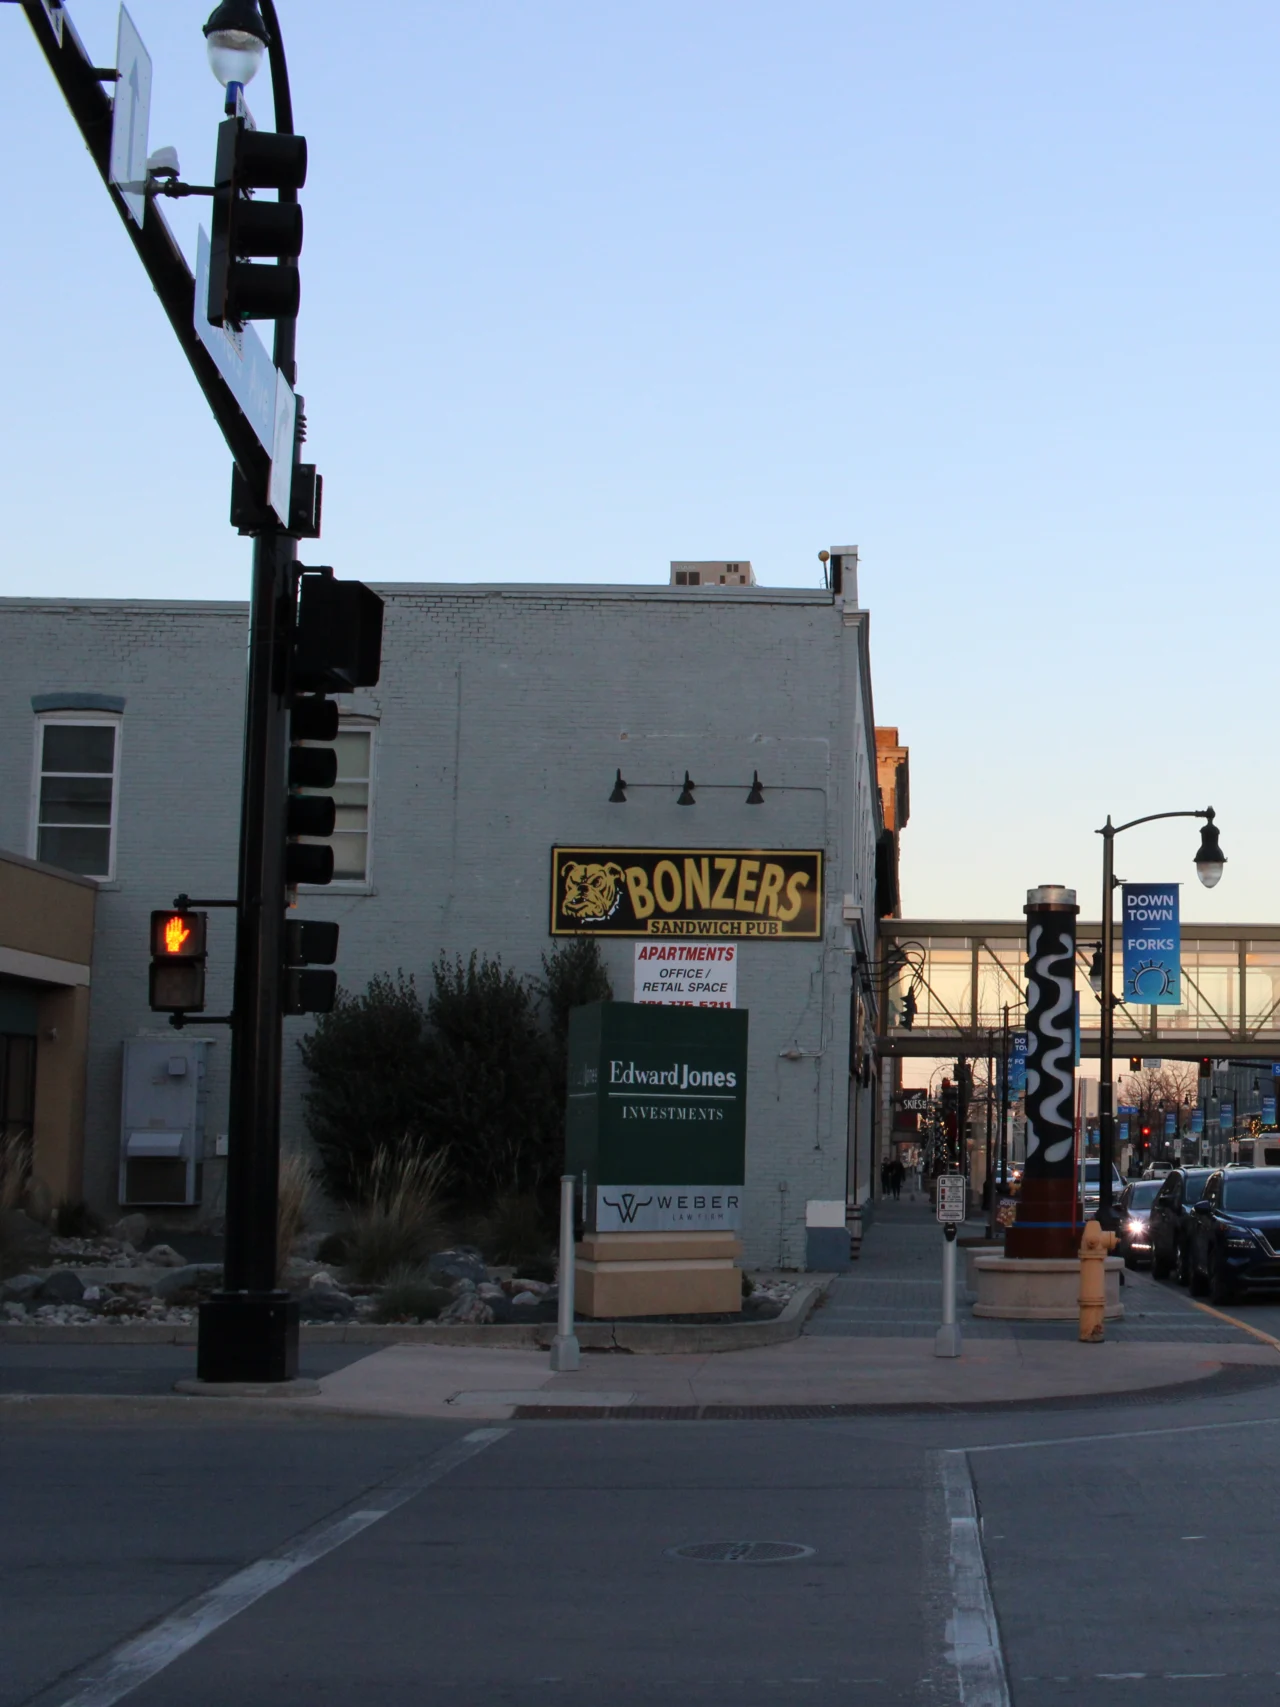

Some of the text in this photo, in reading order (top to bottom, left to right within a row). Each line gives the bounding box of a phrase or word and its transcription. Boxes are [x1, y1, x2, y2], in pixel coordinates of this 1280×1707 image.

[624, 857, 811, 922] BONZERS
[1127, 894, 1174, 906] DOWN
[1127, 909, 1173, 921] TOWN
[651, 920, 779, 935] SANDWICH PUB
[1127, 939, 1175, 951] FORKS
[638, 946, 735, 962] APARTMENTS
[659, 968, 703, 979] OFFICE
[642, 982, 728, 993] RETAIL SPACE
[609, 1060, 679, 1086] Edward
[680, 1064, 737, 1089] Jones
[903, 1099, 922, 1110] SKIES
[622, 1106, 724, 1121] INVESTMENTS
[657, 1196, 739, 1209] WEBER
